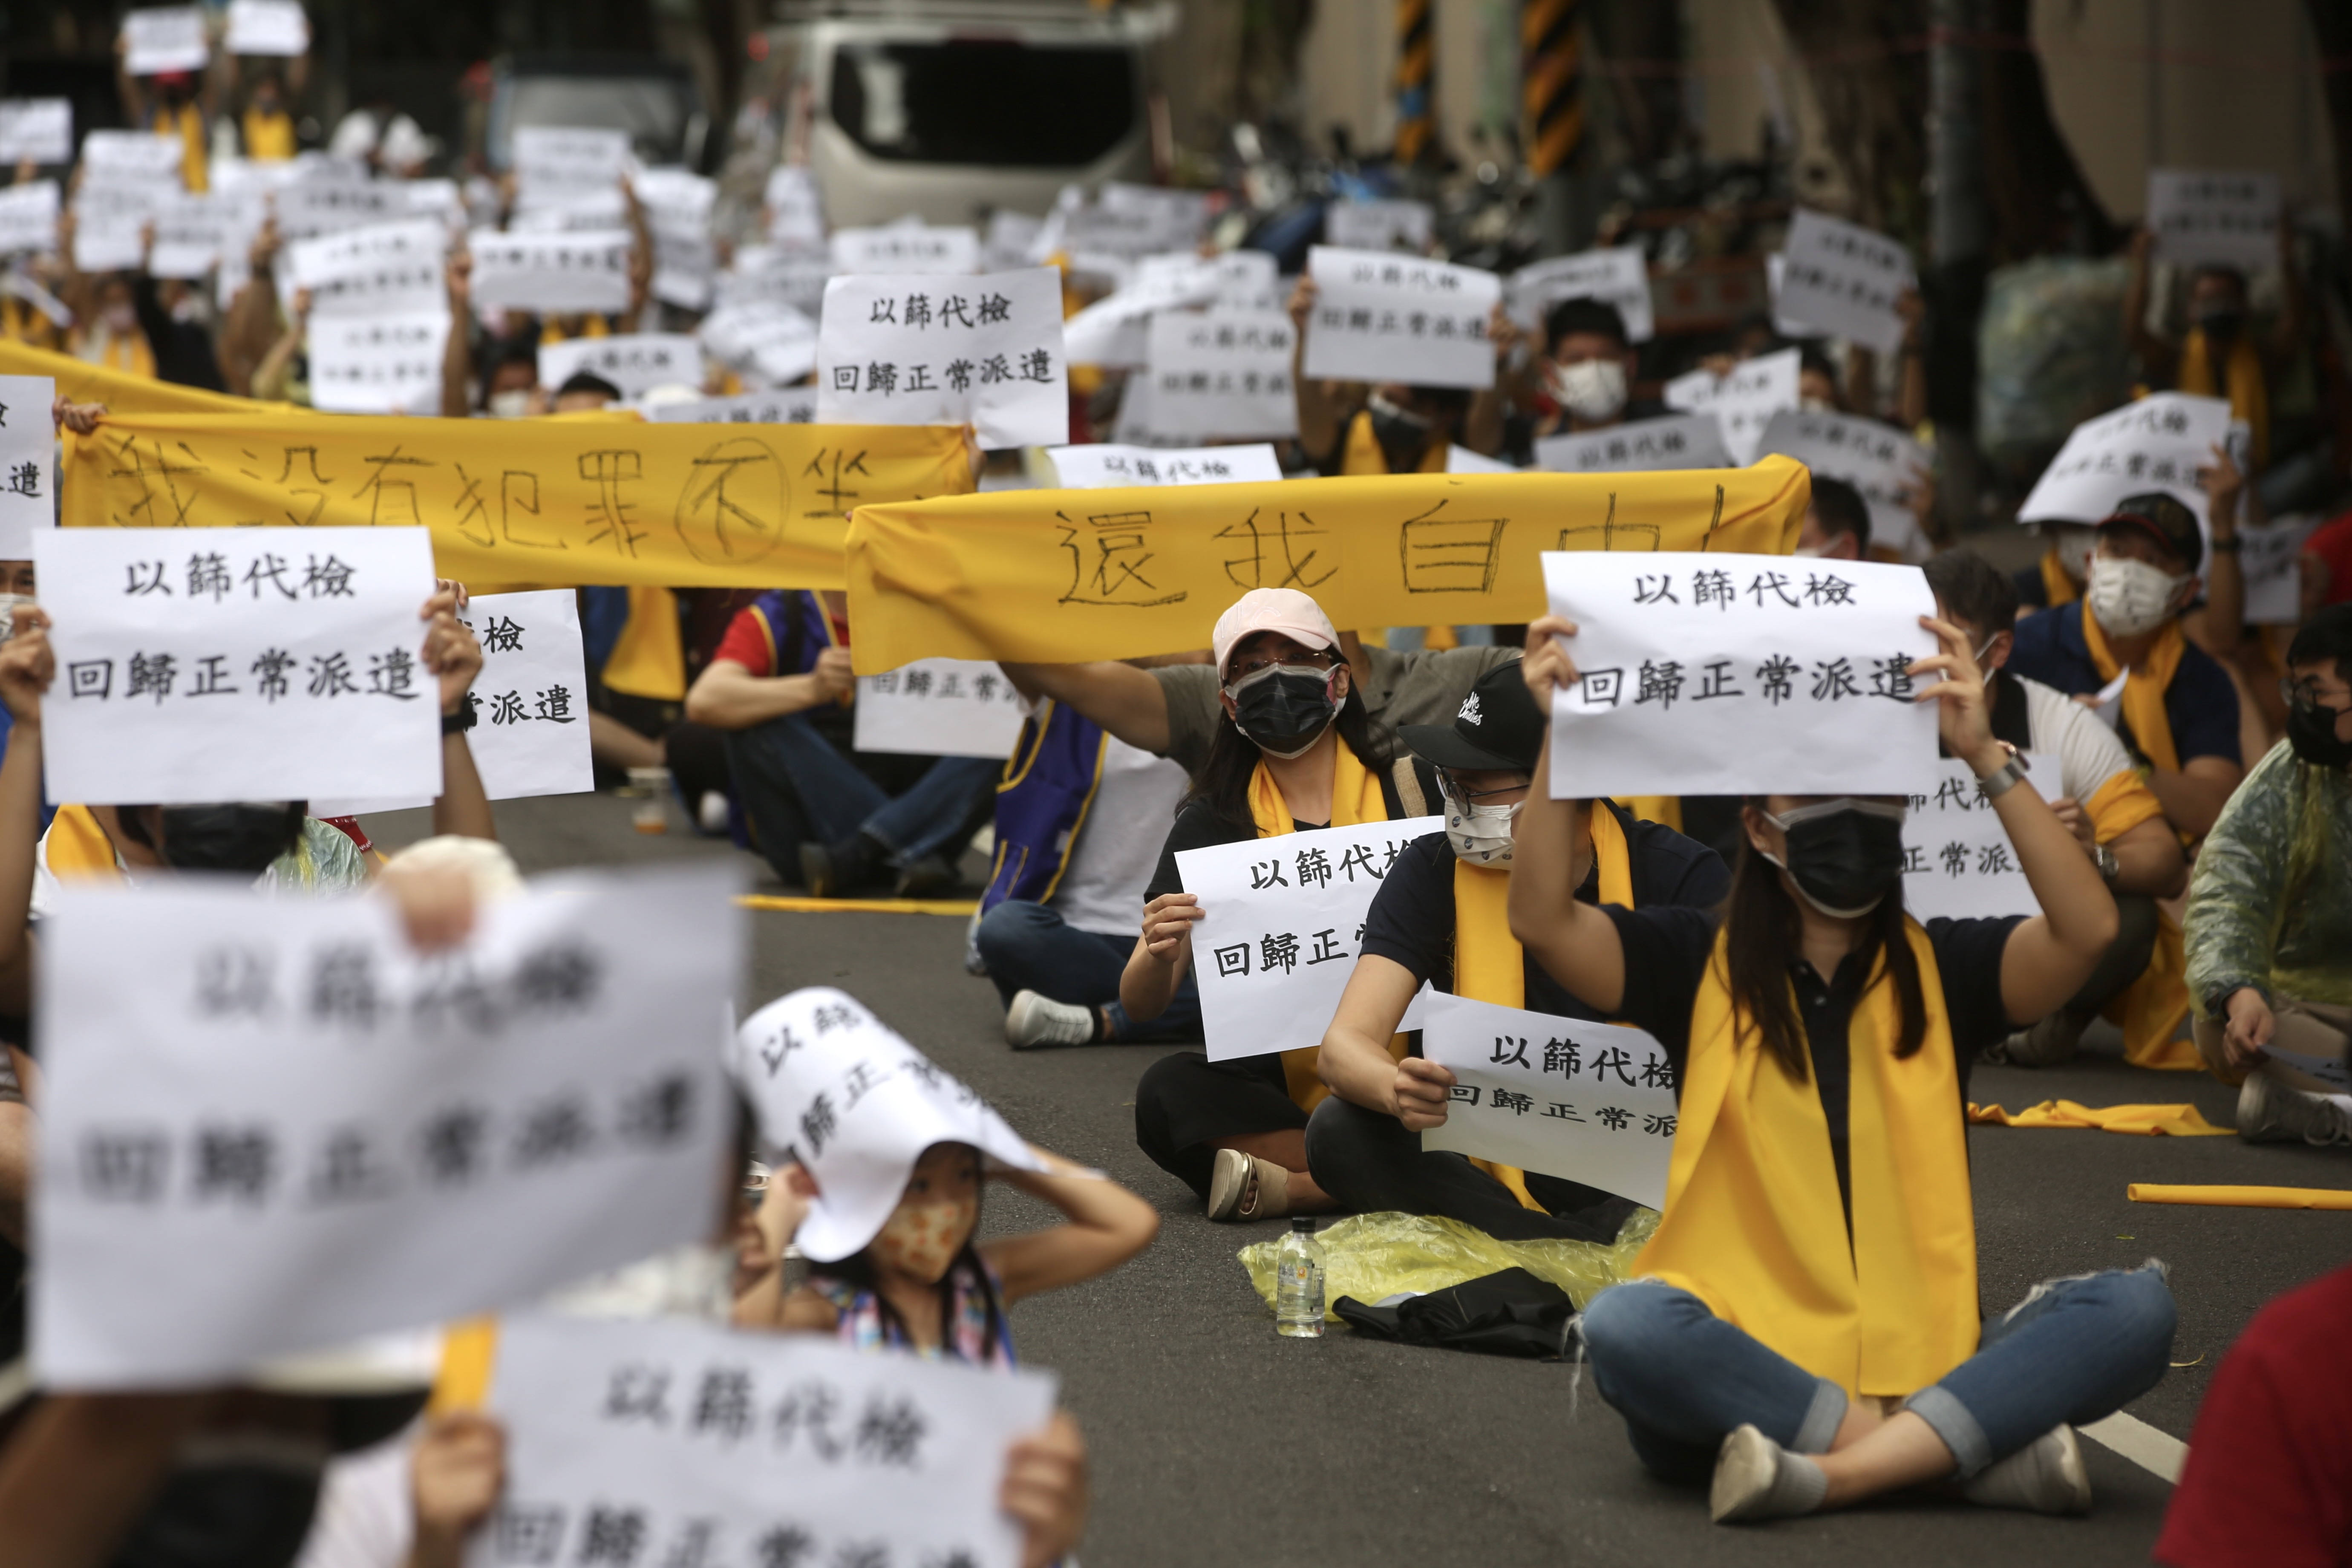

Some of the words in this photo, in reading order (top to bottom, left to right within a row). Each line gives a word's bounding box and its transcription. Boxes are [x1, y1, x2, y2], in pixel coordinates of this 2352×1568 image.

[869, 292, 1013, 330] 以篩代檢
[833, 347, 1055, 397] 回歸正常派遣
[0, 461, 43, 499] 遣
[109, 435, 924, 560] 我沒有犯罪不坐
[123, 552, 358, 602] 以篩代檢
[1634, 569, 1857, 611] 以篩代檢
[67, 647, 422, 704] 回歸正常派遣
[1578, 651, 1915, 710] 回歸正常派遣
[1902, 840, 2025, 879] 正常派
[1214, 923, 1367, 978] 回歸正
[1490, 1035, 1675, 1090] 以篩代檢
[1447, 1084, 1679, 1138] 回歸正常派
